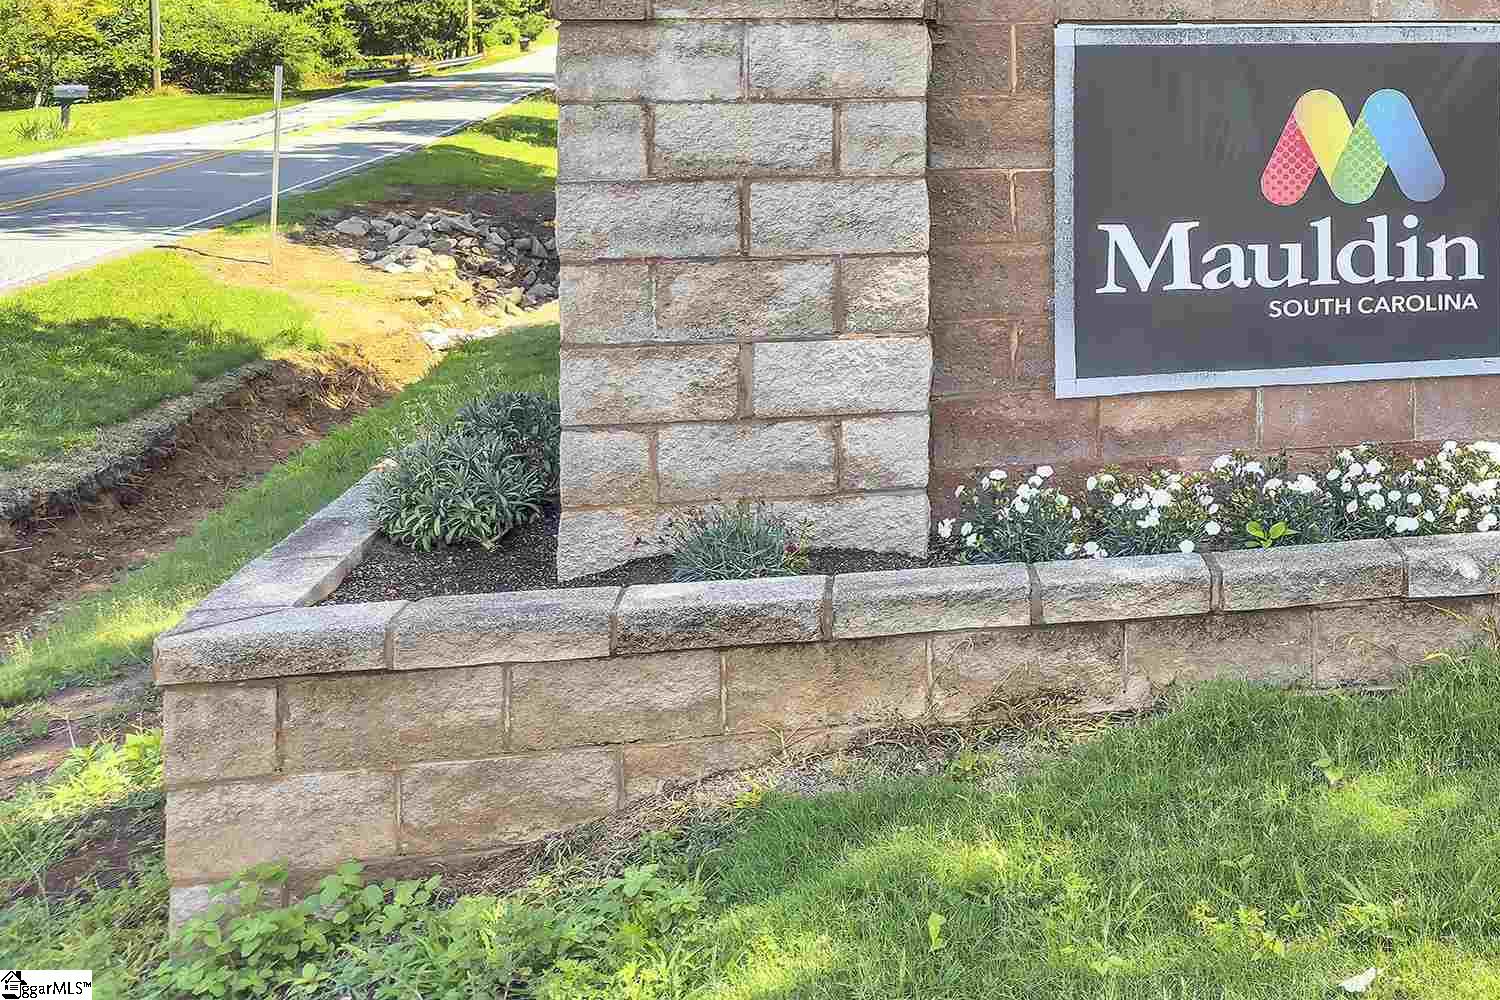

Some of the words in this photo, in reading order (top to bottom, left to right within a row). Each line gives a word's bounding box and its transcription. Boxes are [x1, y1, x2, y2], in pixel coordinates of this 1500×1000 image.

[1094, 213, 1486, 294] Mauldin
[1269, 297, 1351, 318] SOUTH
[1357, 293, 1479, 314] CAROLINA
